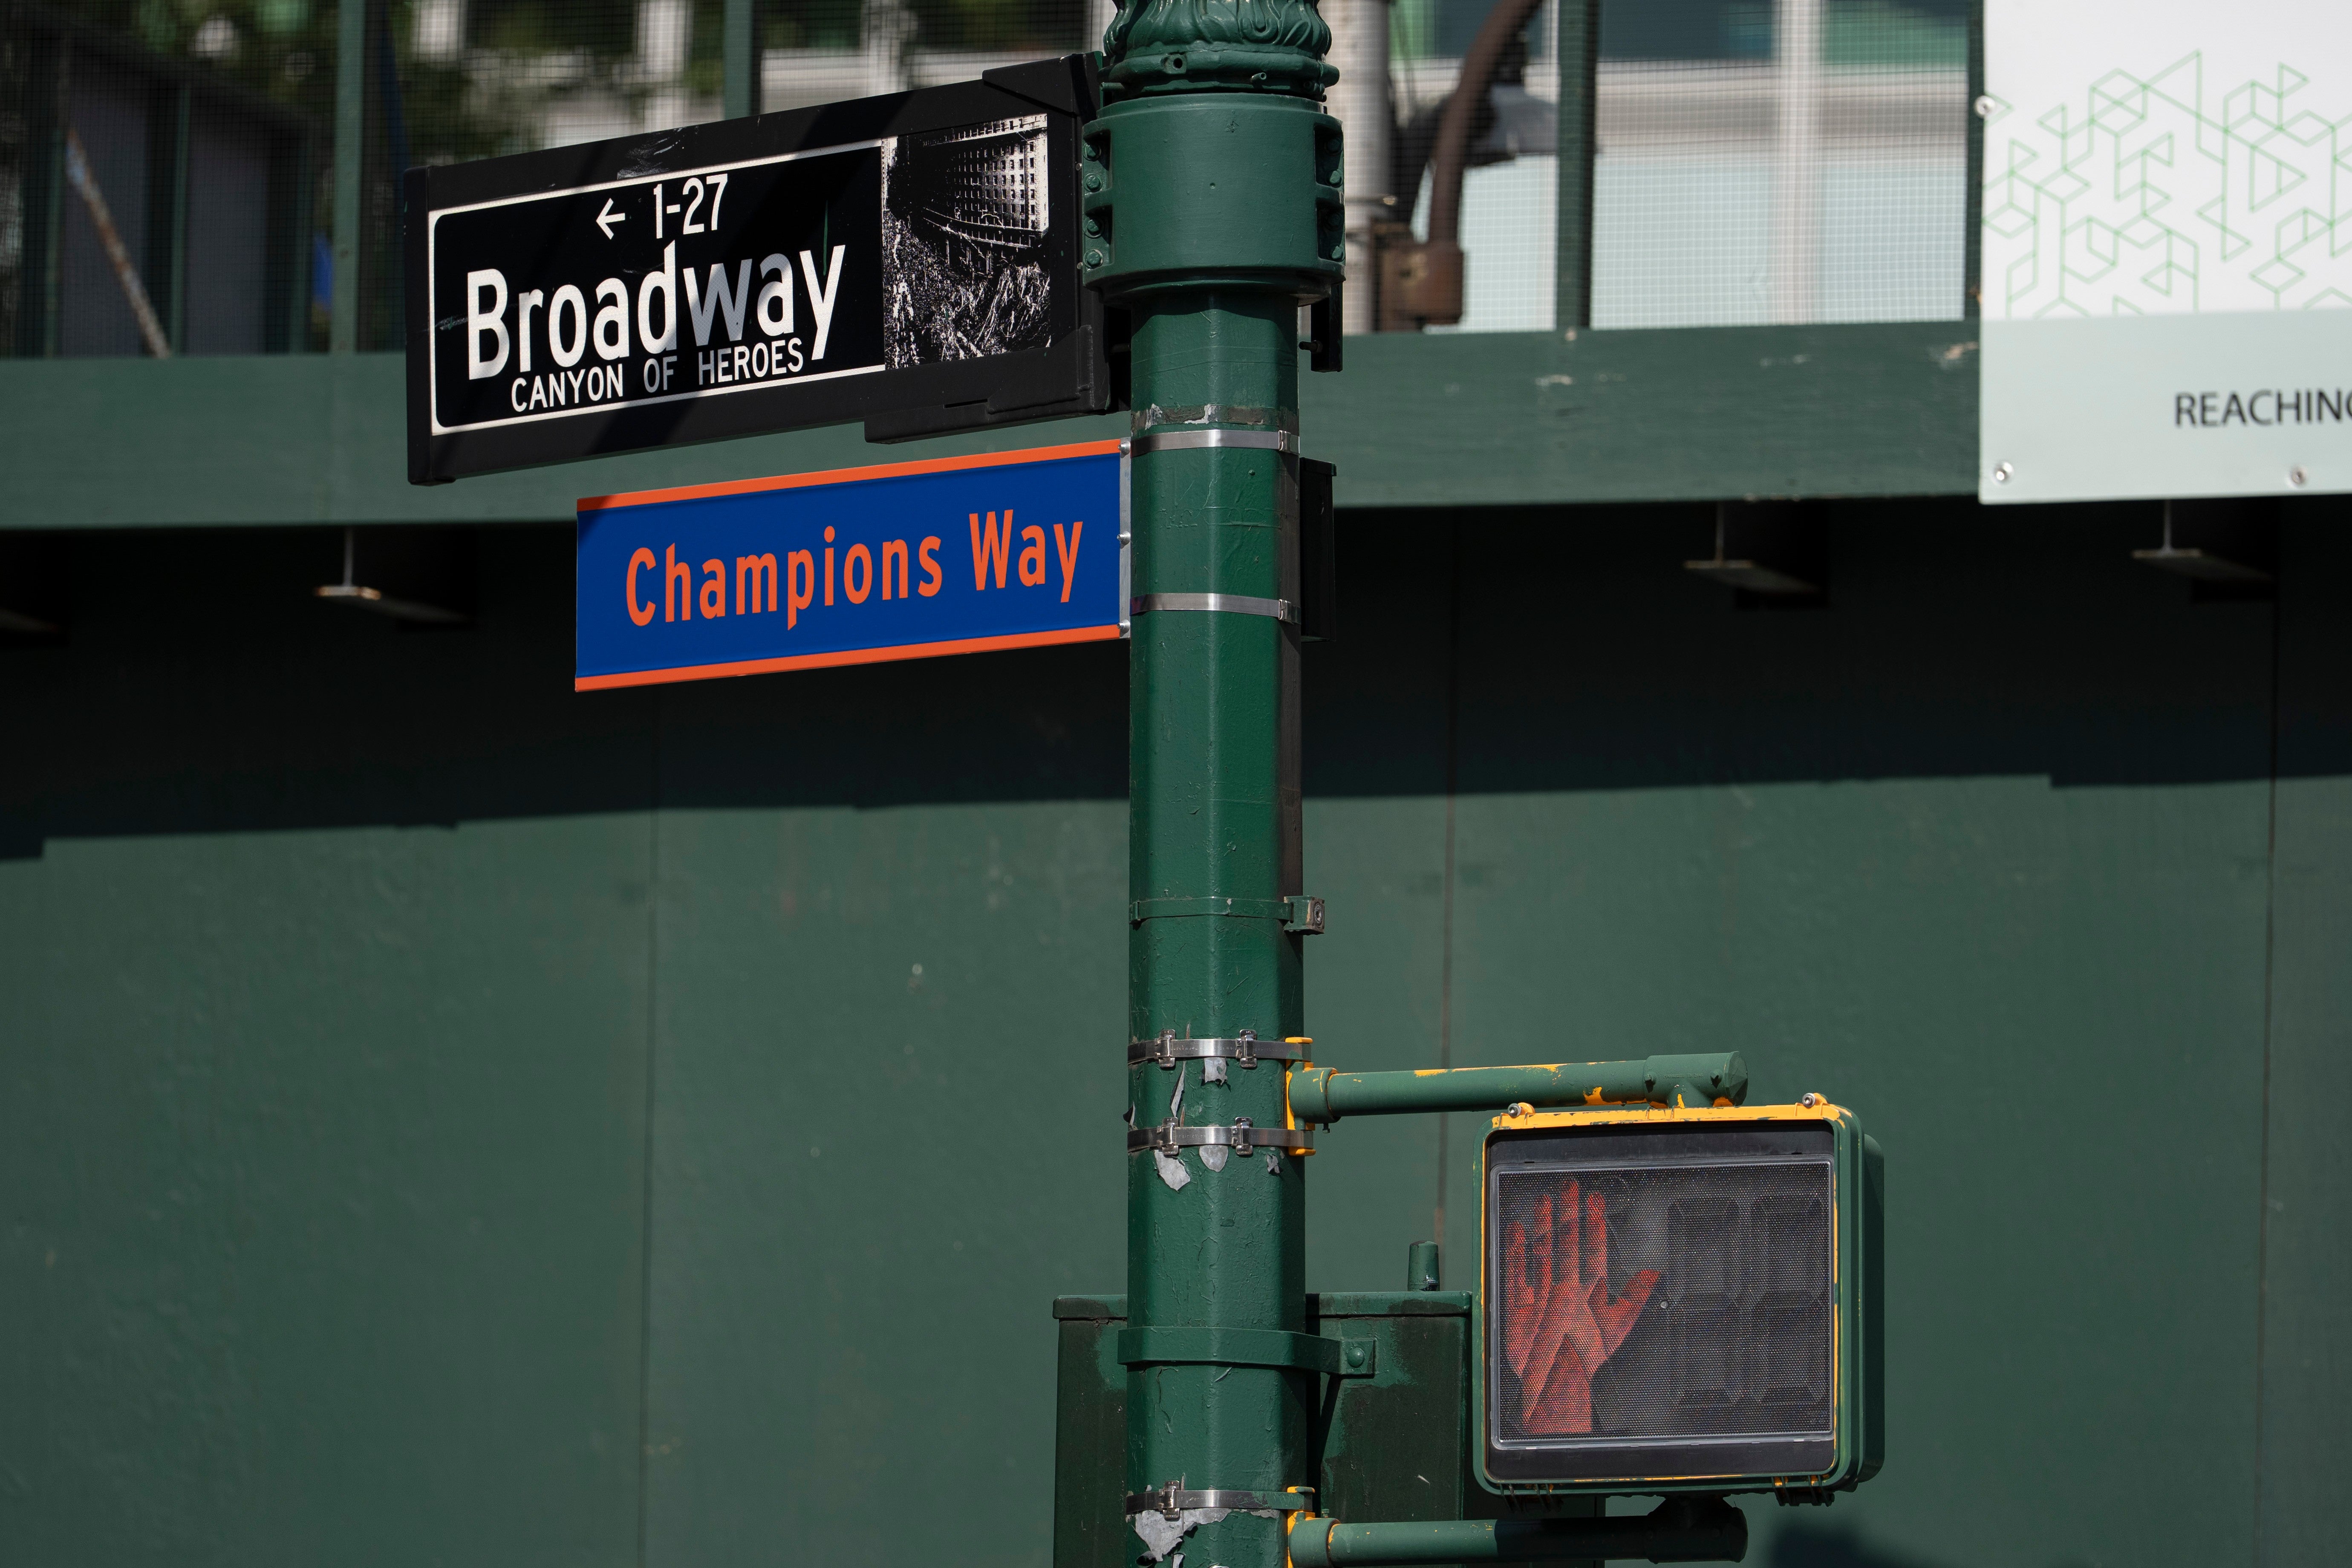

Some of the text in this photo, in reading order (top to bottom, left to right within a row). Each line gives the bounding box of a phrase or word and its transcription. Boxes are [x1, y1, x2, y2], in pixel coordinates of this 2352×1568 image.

[653, 173, 728, 239] 1-27
[468, 240, 846, 380] Broadway
[511, 337, 803, 412] CANYON OF HEROES
[2174, 389, 2352, 427] REACHIN
[626, 509, 1083, 630] Champions Way
